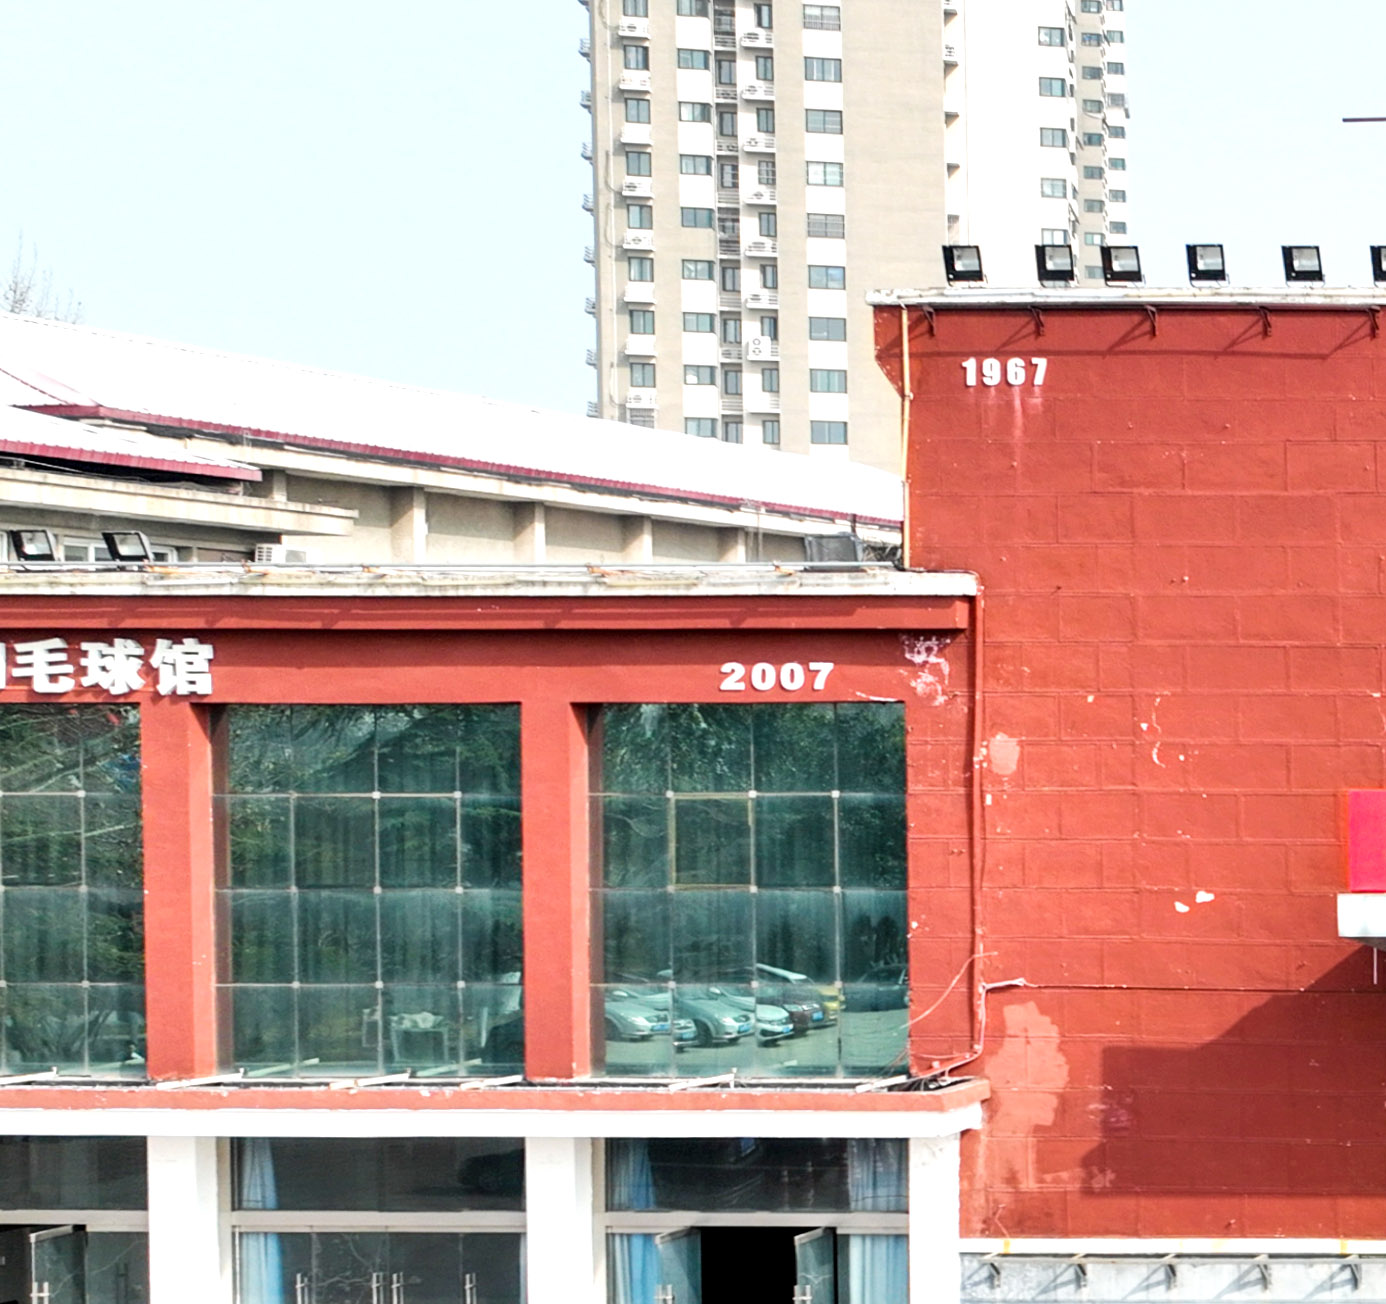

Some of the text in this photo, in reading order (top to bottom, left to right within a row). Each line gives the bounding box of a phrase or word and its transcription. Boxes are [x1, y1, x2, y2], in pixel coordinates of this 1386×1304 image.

[962, 357, 1047, 387] 1967
[0, 637, 214, 695] 毛球馆
[720, 661, 834, 691] 2007
